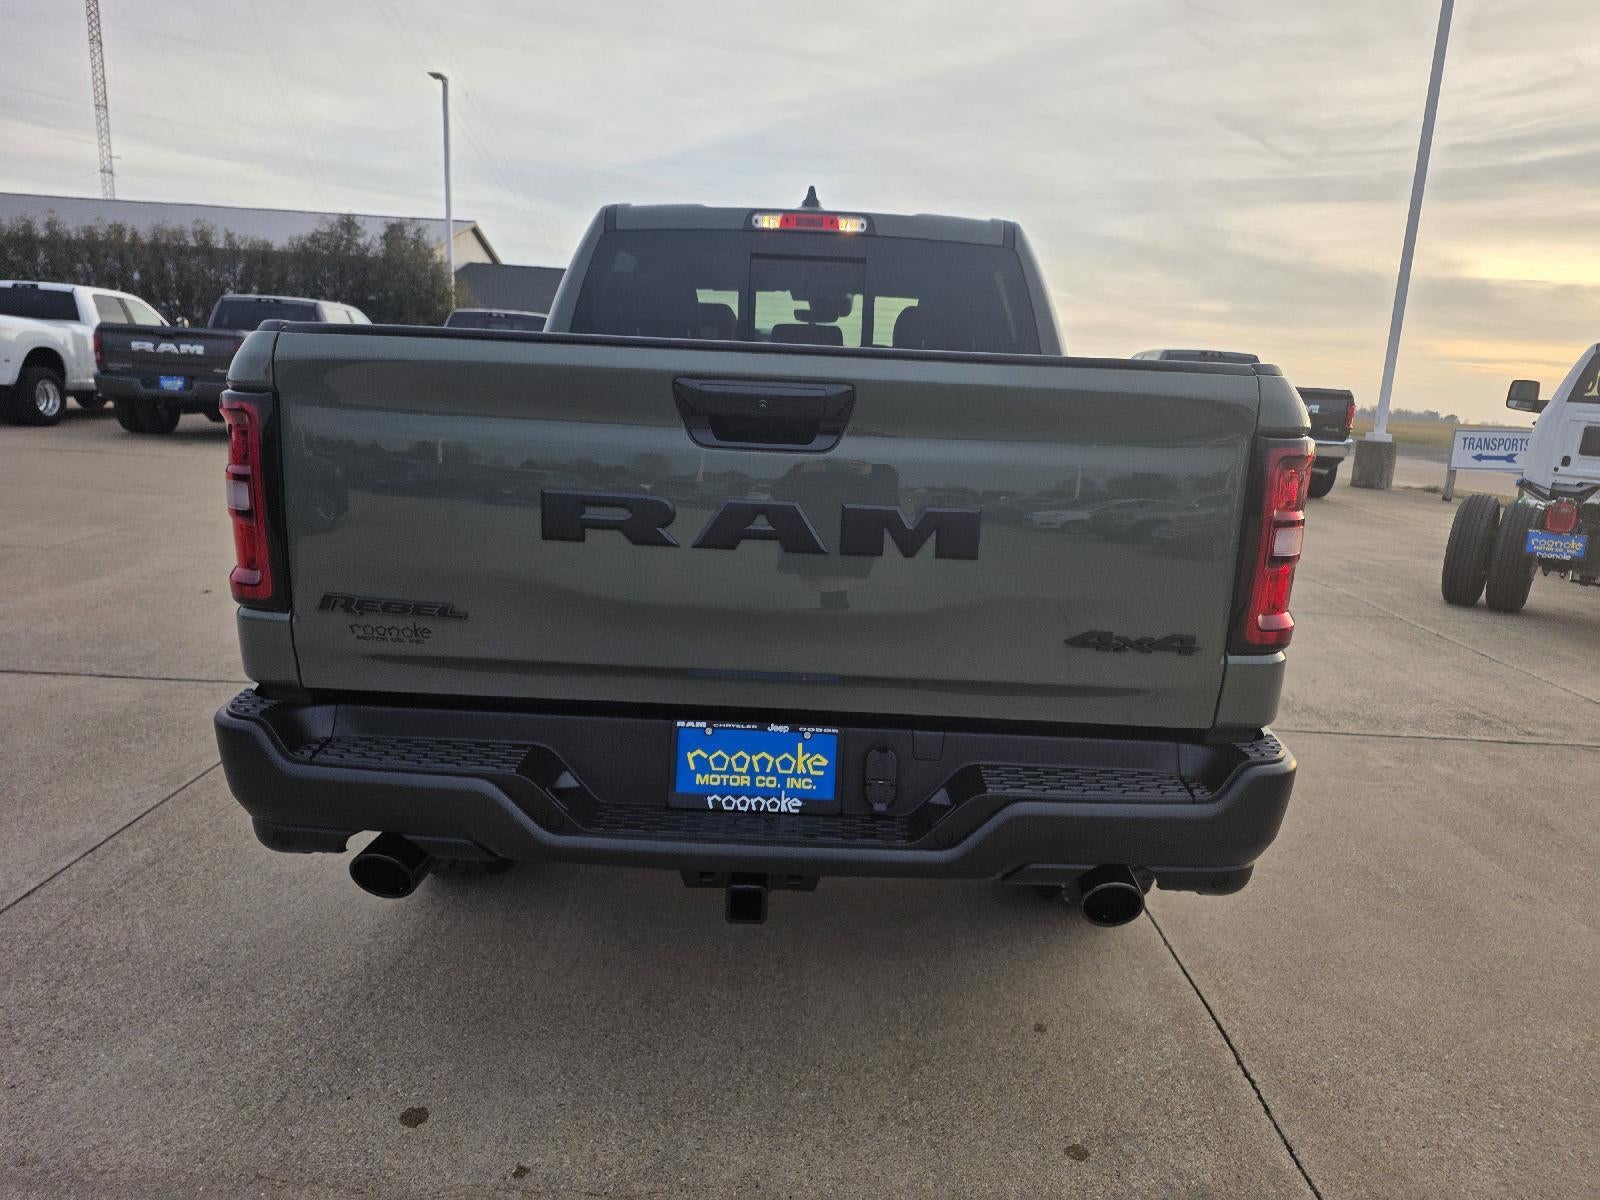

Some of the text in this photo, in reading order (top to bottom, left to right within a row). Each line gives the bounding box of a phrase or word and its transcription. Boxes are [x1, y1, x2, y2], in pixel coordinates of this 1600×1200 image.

[131, 341, 205, 354] RAM
[541, 488, 982, 561] RAM
[319, 592, 468, 621] REBEL
[1064, 630, 1201, 655] 4x4
[767, 723, 790, 733] Jeep
[687, 742, 829, 776] roanoke
[695, 774, 817, 790] MOTOR CO. INC.
[706, 790, 803, 813] roanoke
